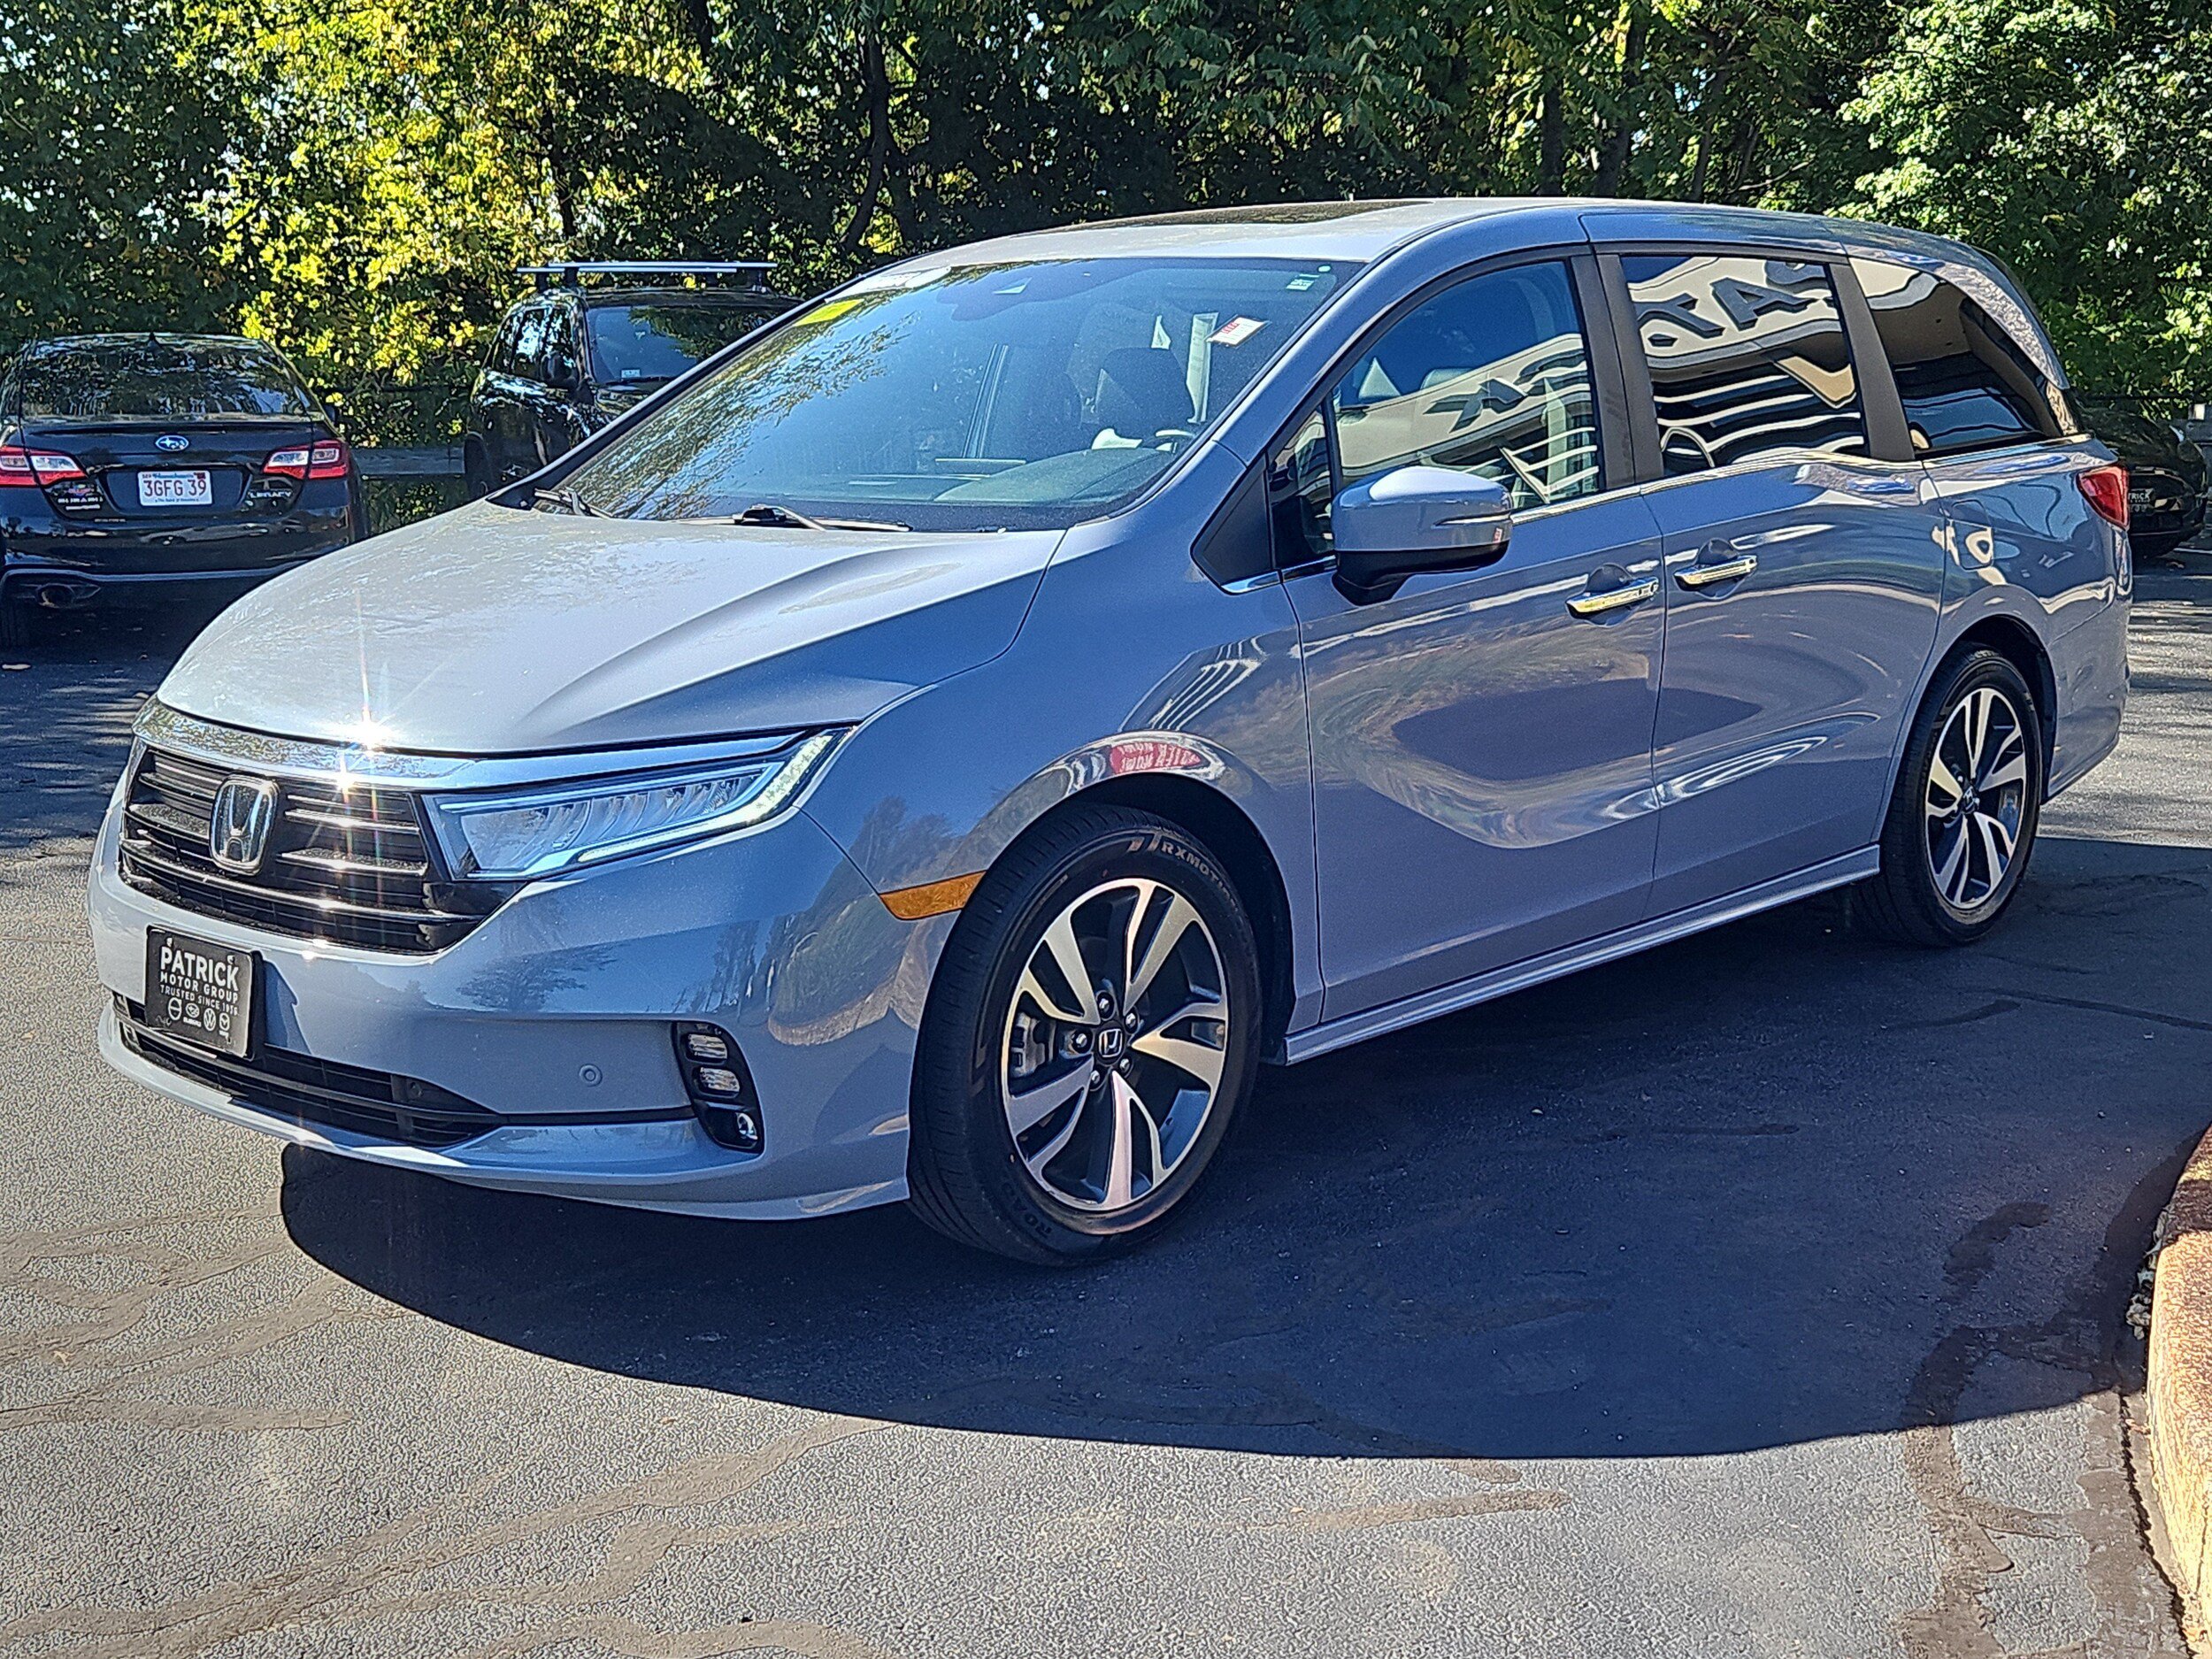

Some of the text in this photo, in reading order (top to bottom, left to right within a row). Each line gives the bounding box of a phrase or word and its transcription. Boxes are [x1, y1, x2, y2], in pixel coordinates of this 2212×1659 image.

[143, 479, 206, 496] 3GFG 39
[159, 946, 239, 992] PATRICK
[159, 972, 239, 1004] MOTOR GROUP
[159, 984, 196, 1002] TRUSTED
[197, 995, 220, 1010] SINCE
